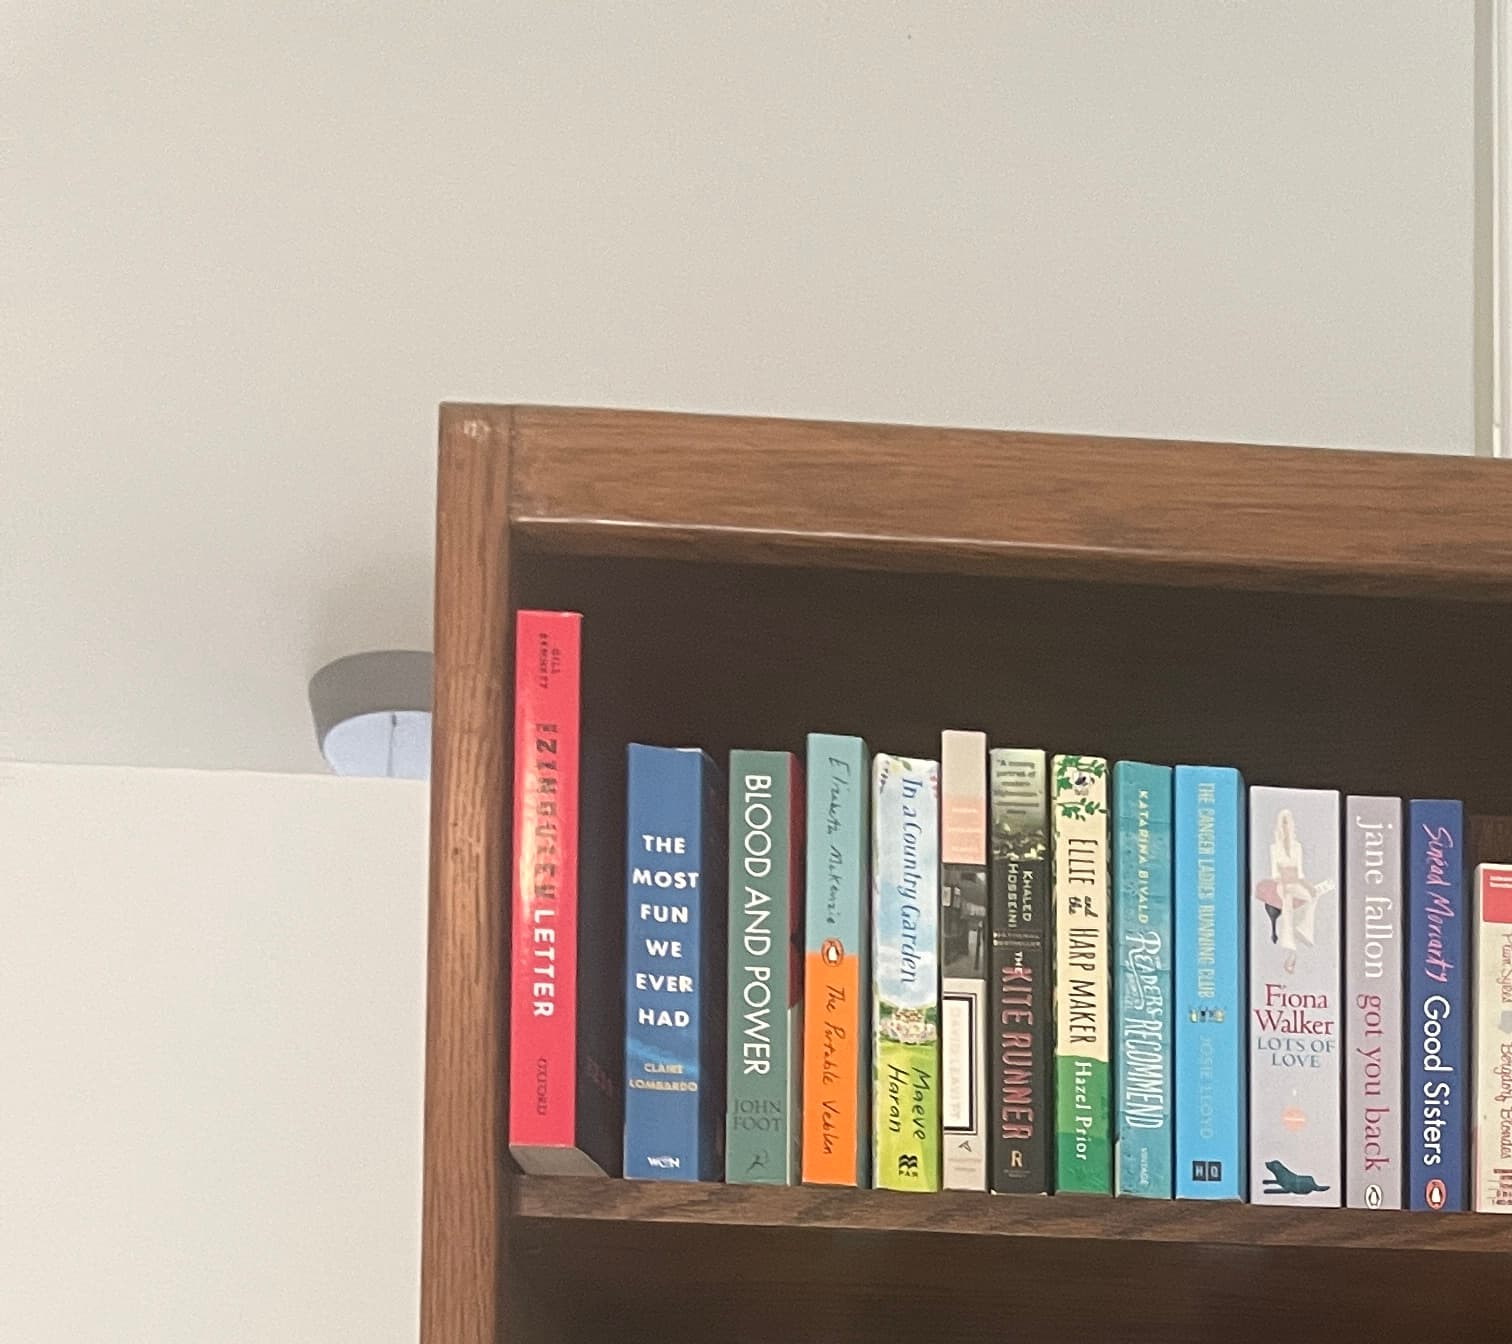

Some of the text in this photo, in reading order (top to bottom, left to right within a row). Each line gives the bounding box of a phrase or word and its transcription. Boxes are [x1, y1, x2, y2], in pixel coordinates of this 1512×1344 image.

[643, 835, 686, 853] THE
[632, 871, 699, 888] MOST
[1357, 817, 1393, 978] jane fallon
[640, 905, 688, 923] FUN
[743, 774, 772, 1075] BLOOD AND POWER
[645, 940, 682, 958] WE
[533, 910, 555, 1016] LETTER
[635, 975, 693, 993] EVER
[1265, 984, 1328, 1009] Fiona
[638, 1009, 690, 1028] HAD
[1254, 1010, 1335, 1036] Walker
[1258, 1038, 1336, 1053] LOTS OF
[1271, 1053, 1321, 1068] LOVE
[1357, 995, 1390, 1171] got you back
[1423, 996, 1452, 1166] Good Sisters
[888, 1064, 908, 1133] Haran
[908, 1068, 931, 1140] Maeve
